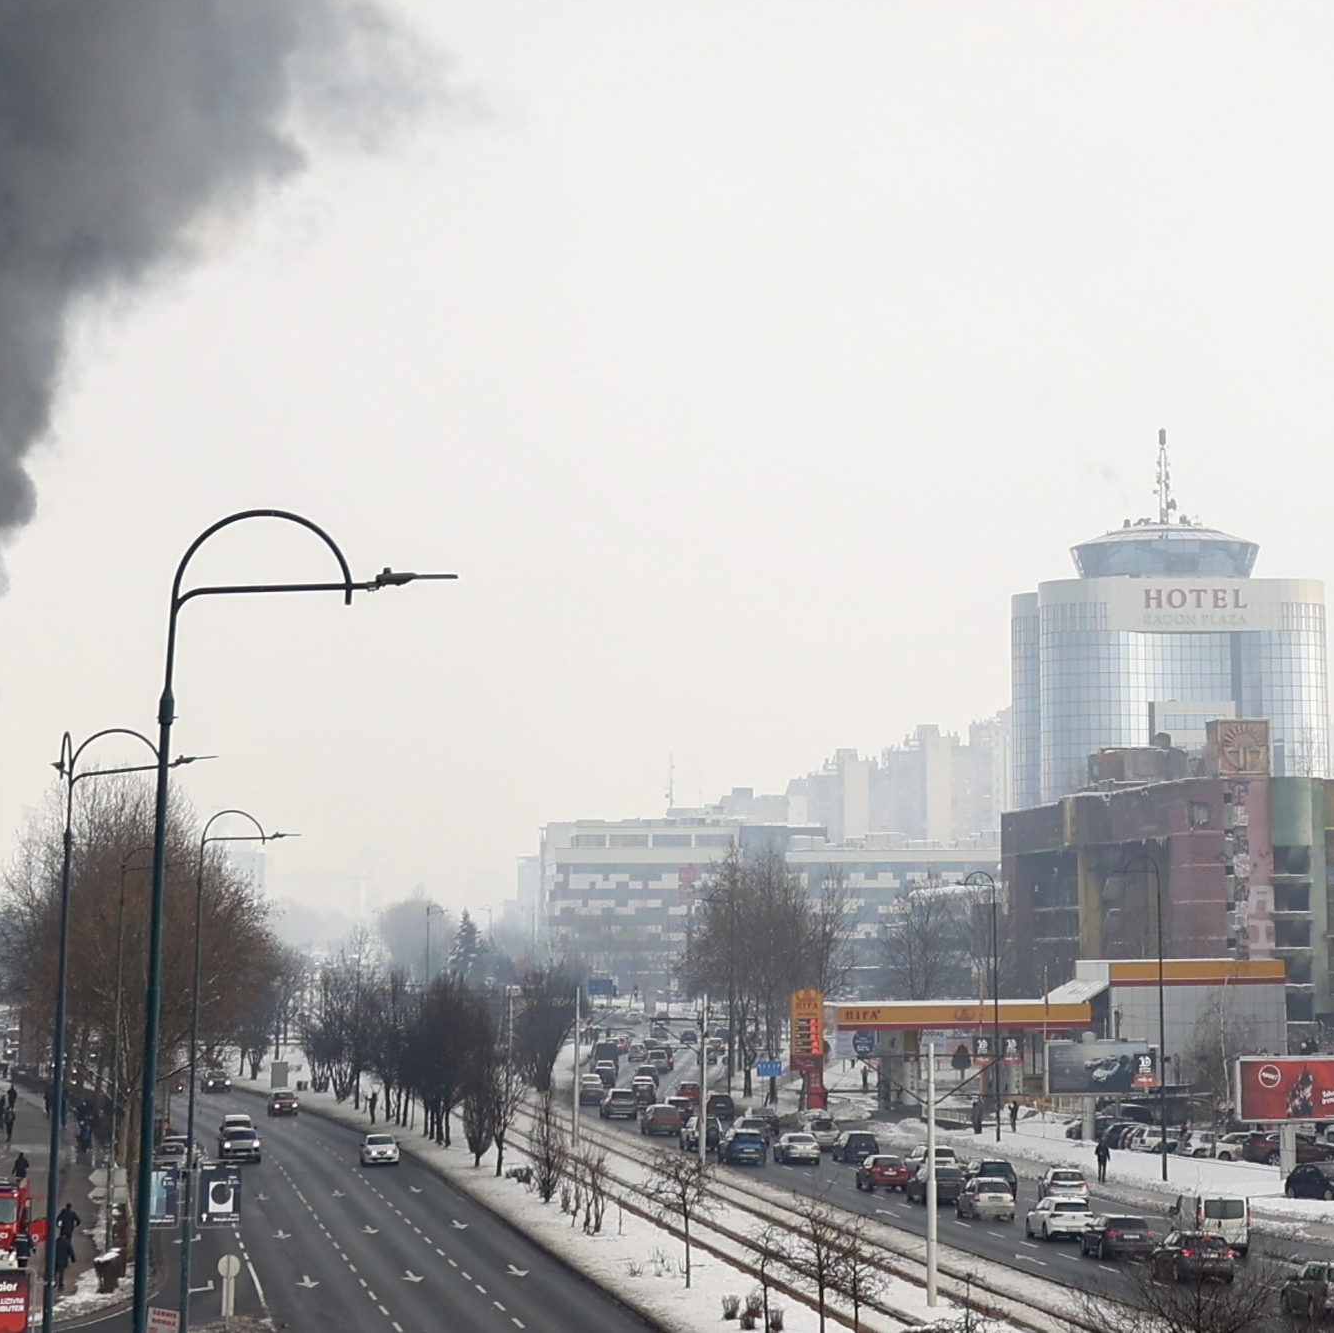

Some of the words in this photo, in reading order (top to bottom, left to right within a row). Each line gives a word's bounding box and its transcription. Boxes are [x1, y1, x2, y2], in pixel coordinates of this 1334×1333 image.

[1144, 589, 1248, 609] HOTEL
[1144, 613, 1196, 626] RADON
[1201, 613, 1248, 626] PLAZA
[846, 1009, 879, 1020] HIFA
